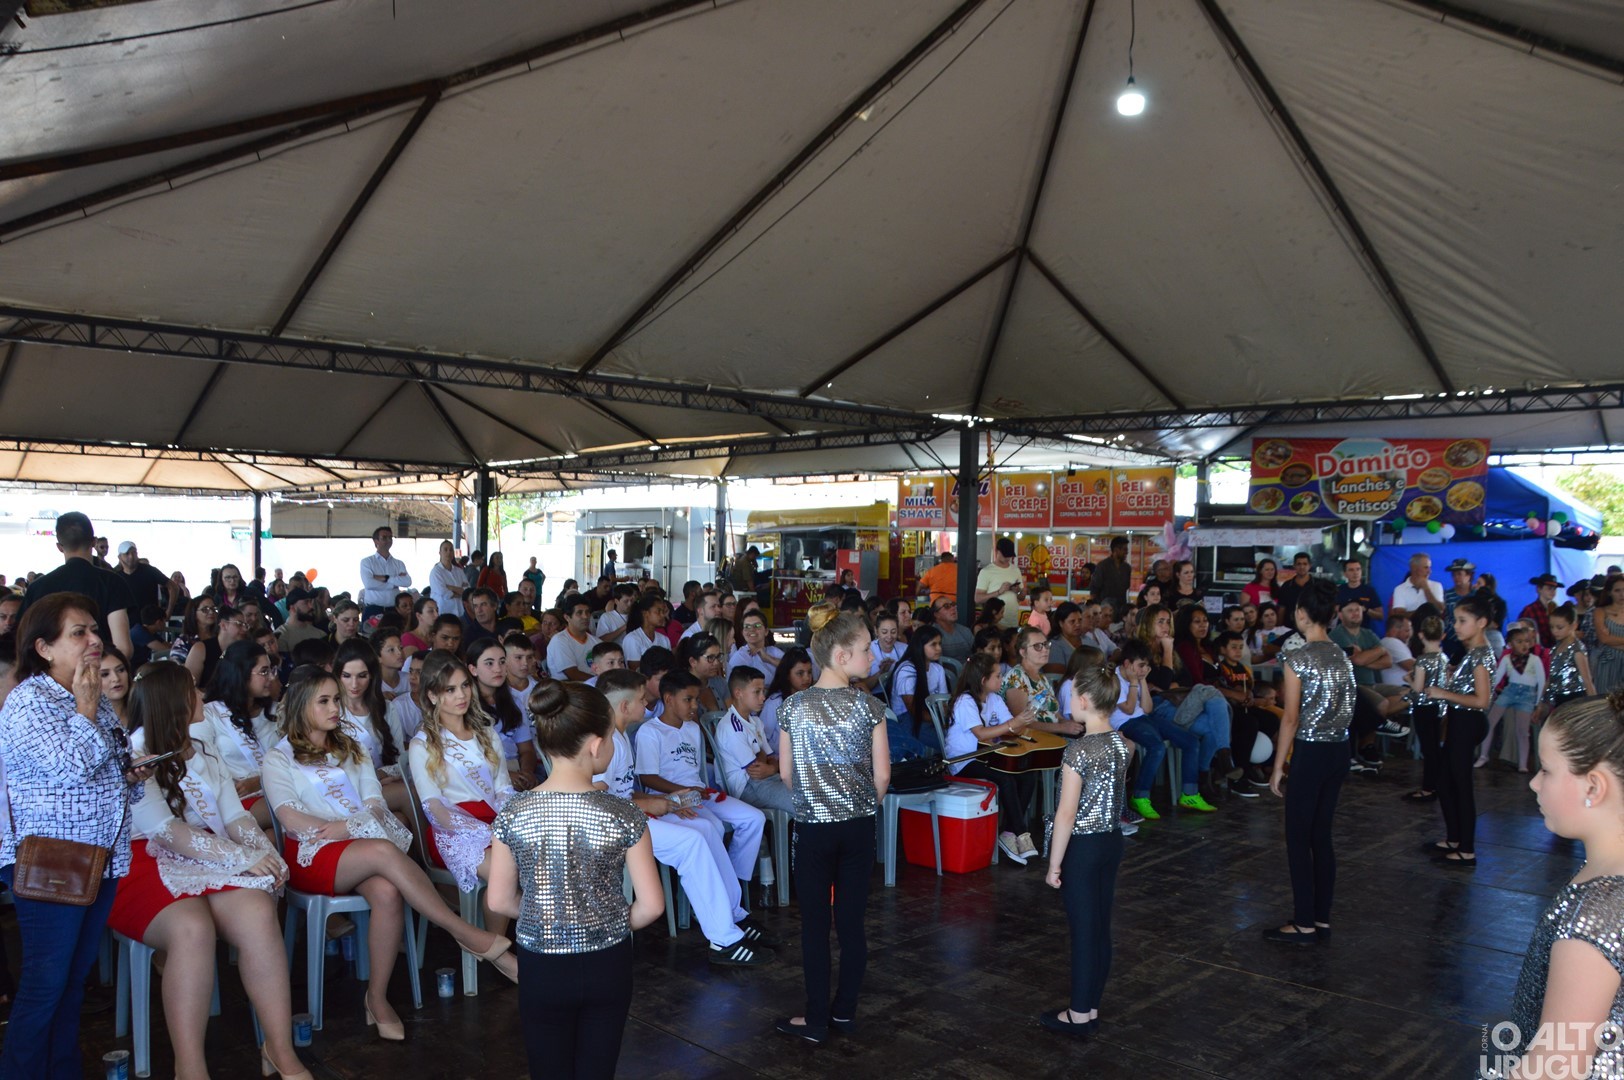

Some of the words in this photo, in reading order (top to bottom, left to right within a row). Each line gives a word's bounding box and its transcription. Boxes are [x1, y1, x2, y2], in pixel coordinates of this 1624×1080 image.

[1315, 446, 1430, 478] Damião
[1005, 485, 1026, 497] REI
[1061, 482, 1083, 494] REI
[1121, 480, 1144, 493] REI
[1331, 477, 1391, 494] Lanches
[1395, 480, 1405, 489] e
[905, 497, 936, 506] MILK
[1010, 497, 1048, 511] CREPE
[1067, 494, 1107, 510] CREPE
[1127, 493, 1170, 508] CREPE
[1338, 499, 1398, 513] Petiscos
[899, 508, 942, 519] SHAKE
[1047, 545, 1067, 556] REI
